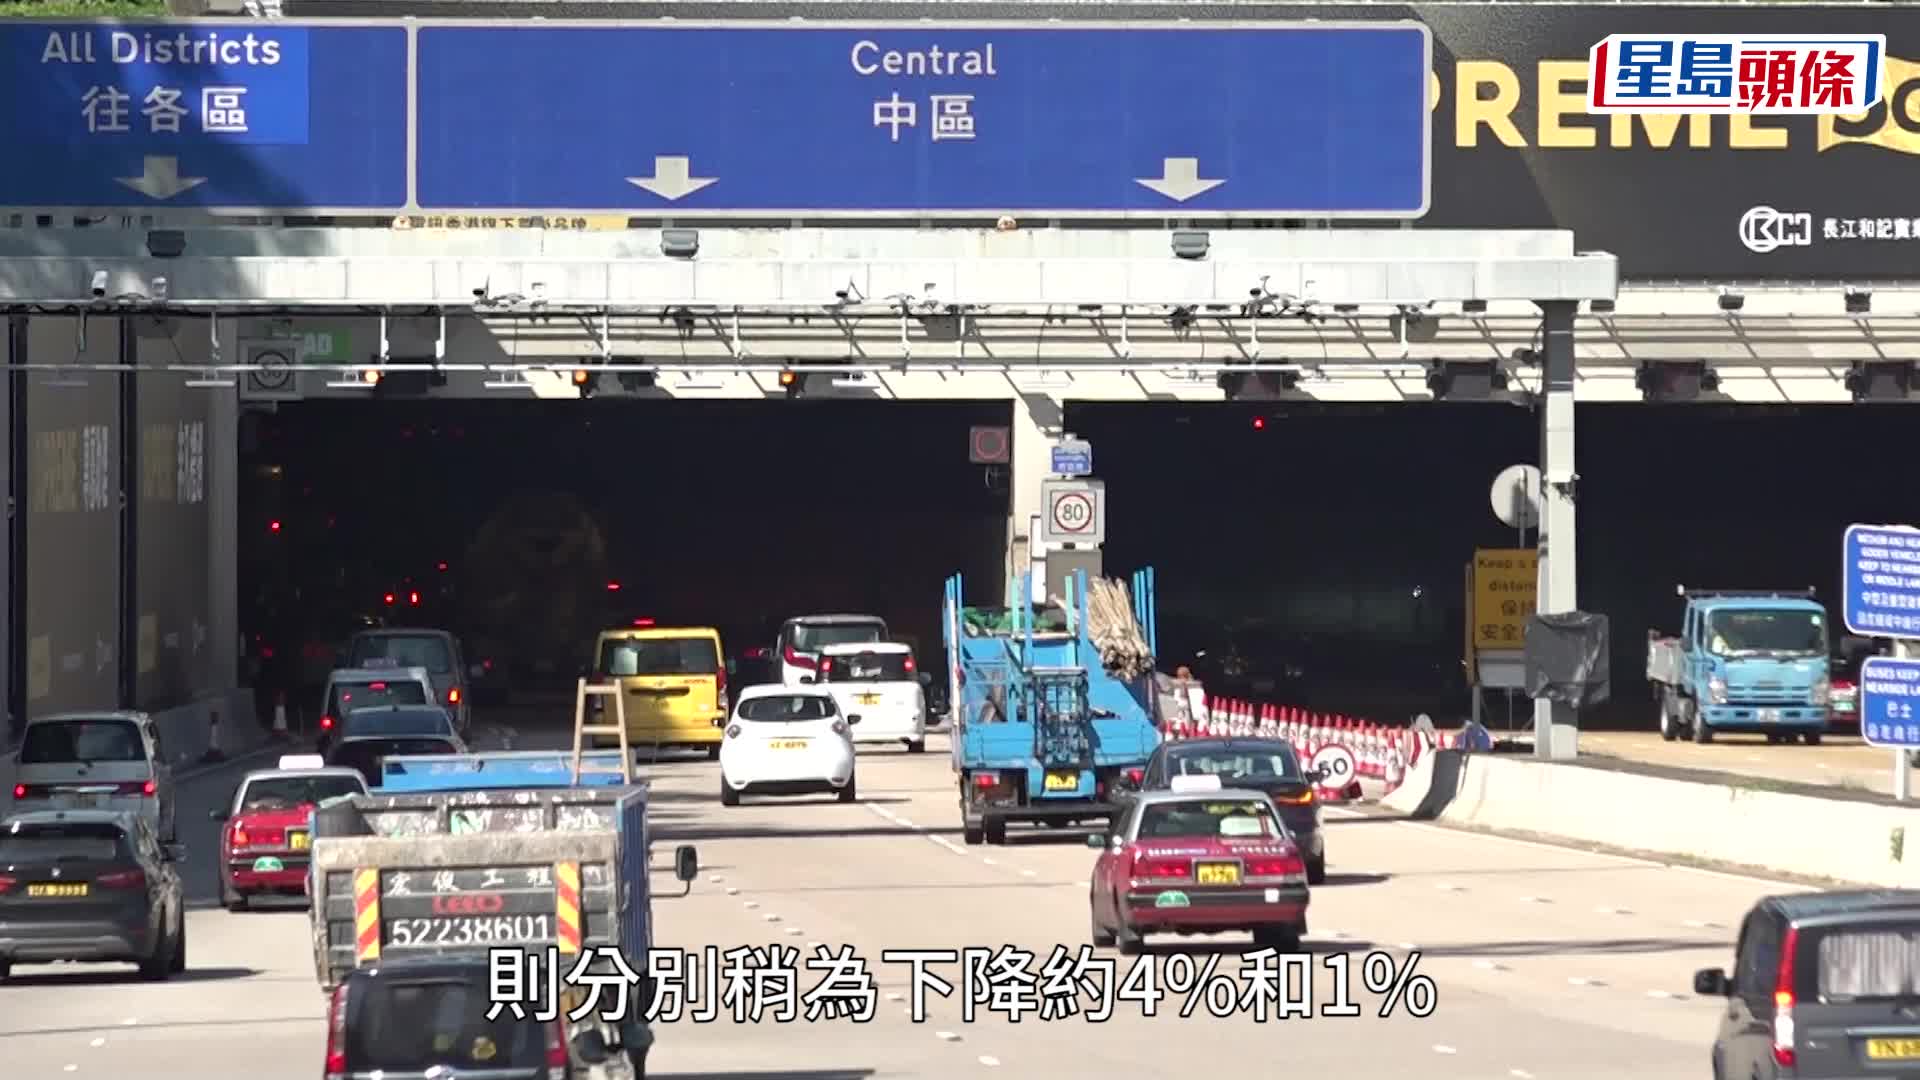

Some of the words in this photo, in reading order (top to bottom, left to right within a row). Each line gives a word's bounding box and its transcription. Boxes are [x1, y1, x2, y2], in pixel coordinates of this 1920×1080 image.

[41, 32, 96, 64] All
[111, 31, 281, 65] Districts
[851, 40, 997, 75] Central
[82, 85, 249, 133] 往各區
[873, 92, 976, 142] 中區
[1062, 503, 1084, 521] 80
[392, 915, 549, 946] 52238601
